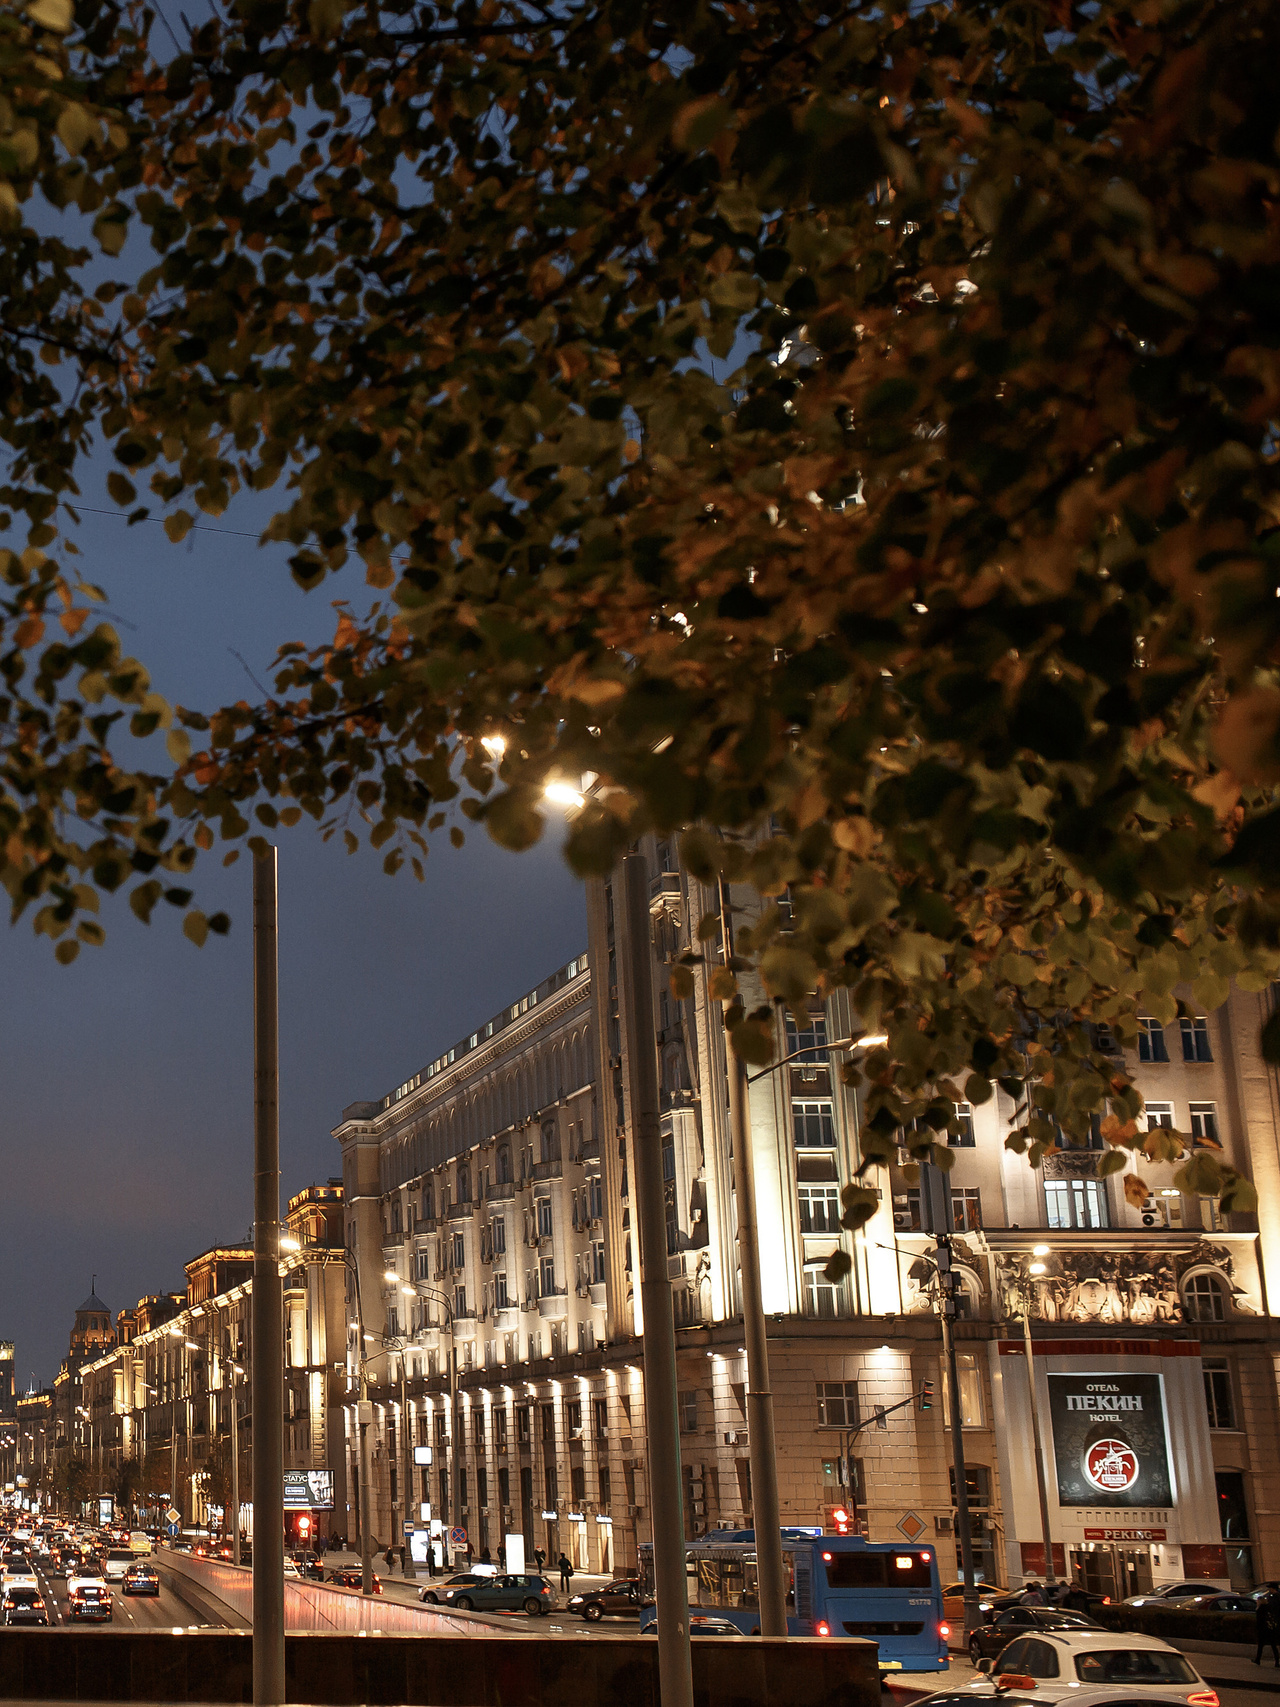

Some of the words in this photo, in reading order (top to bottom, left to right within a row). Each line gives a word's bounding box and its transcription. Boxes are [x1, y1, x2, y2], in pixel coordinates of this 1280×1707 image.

[1086, 1384, 1120, 1392] ОТЕЛЬ
[1066, 1395, 1143, 1411] ПЕКИН
[1089, 1414, 1122, 1422] HOTEL
[1103, 1530, 1153, 1540] PEKING
